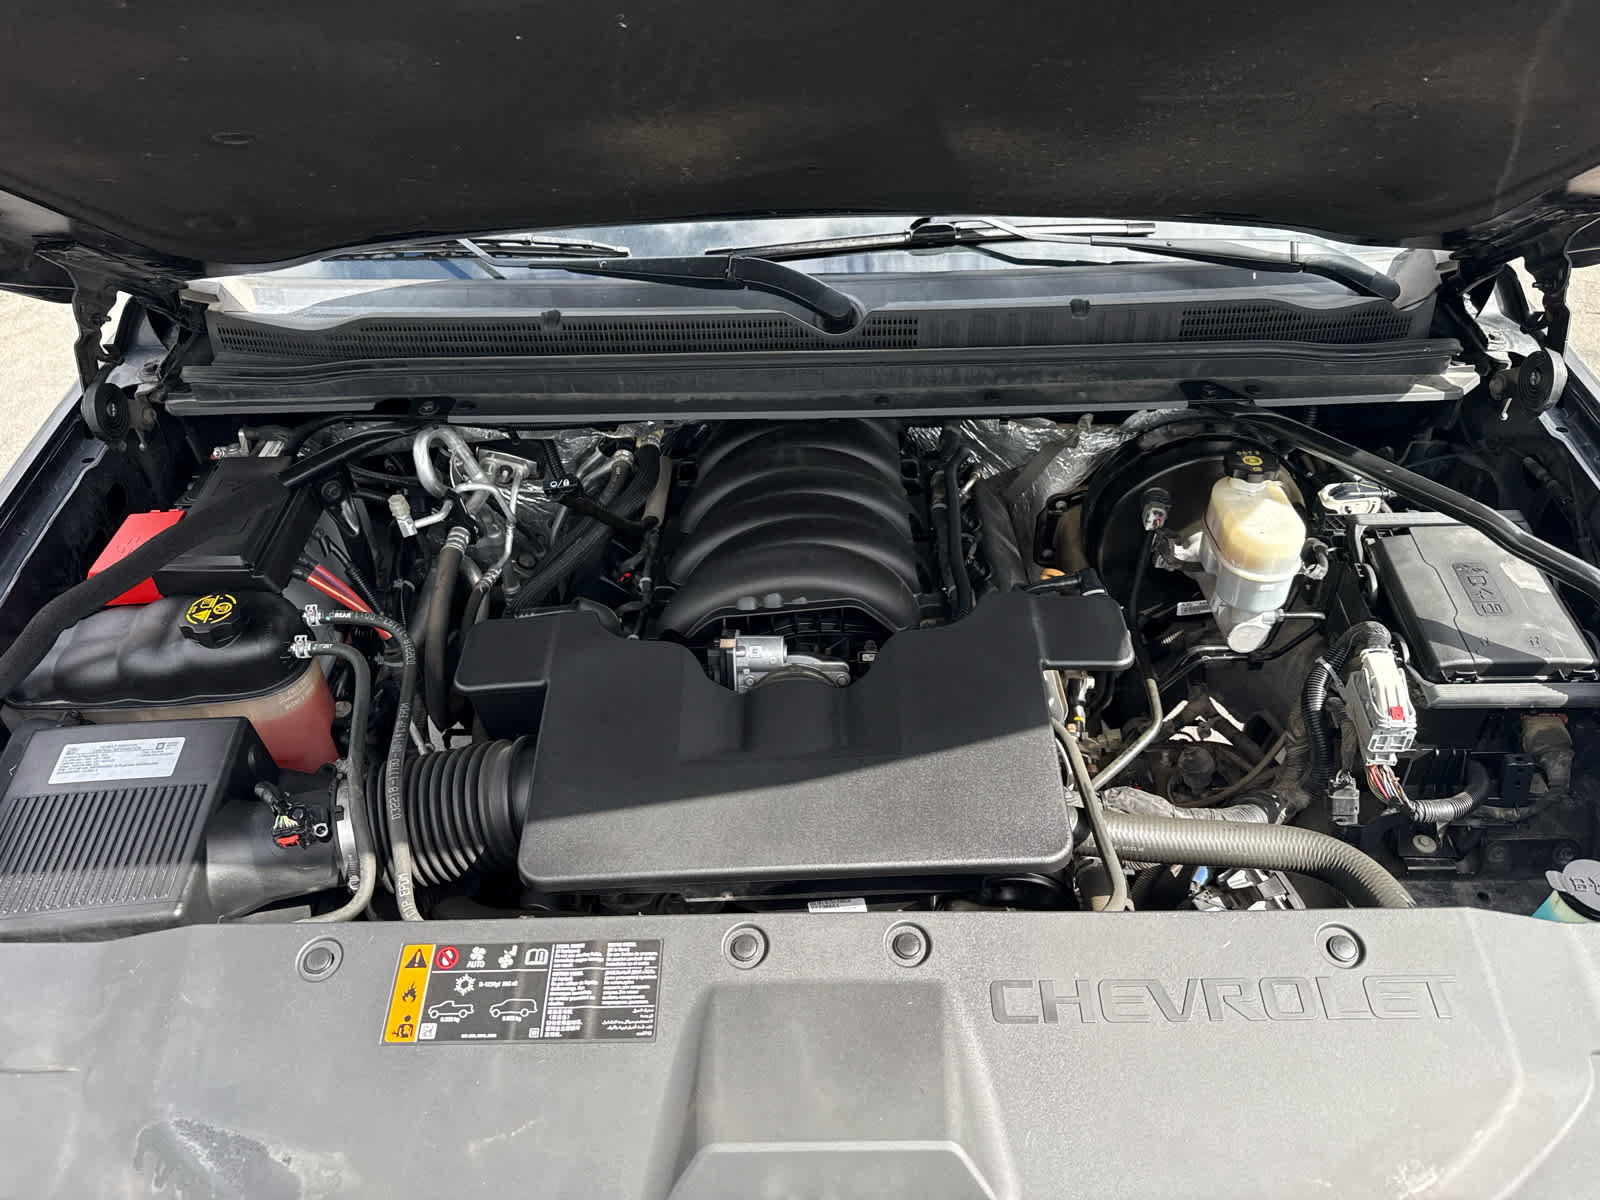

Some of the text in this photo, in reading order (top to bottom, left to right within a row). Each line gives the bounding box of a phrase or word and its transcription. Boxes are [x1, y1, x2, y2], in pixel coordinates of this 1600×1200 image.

[398, 873, 411, 897] EPDM
[466, 960, 486, 969] AUTO
[990, 974, 1456, 1025] CHEVROLET
